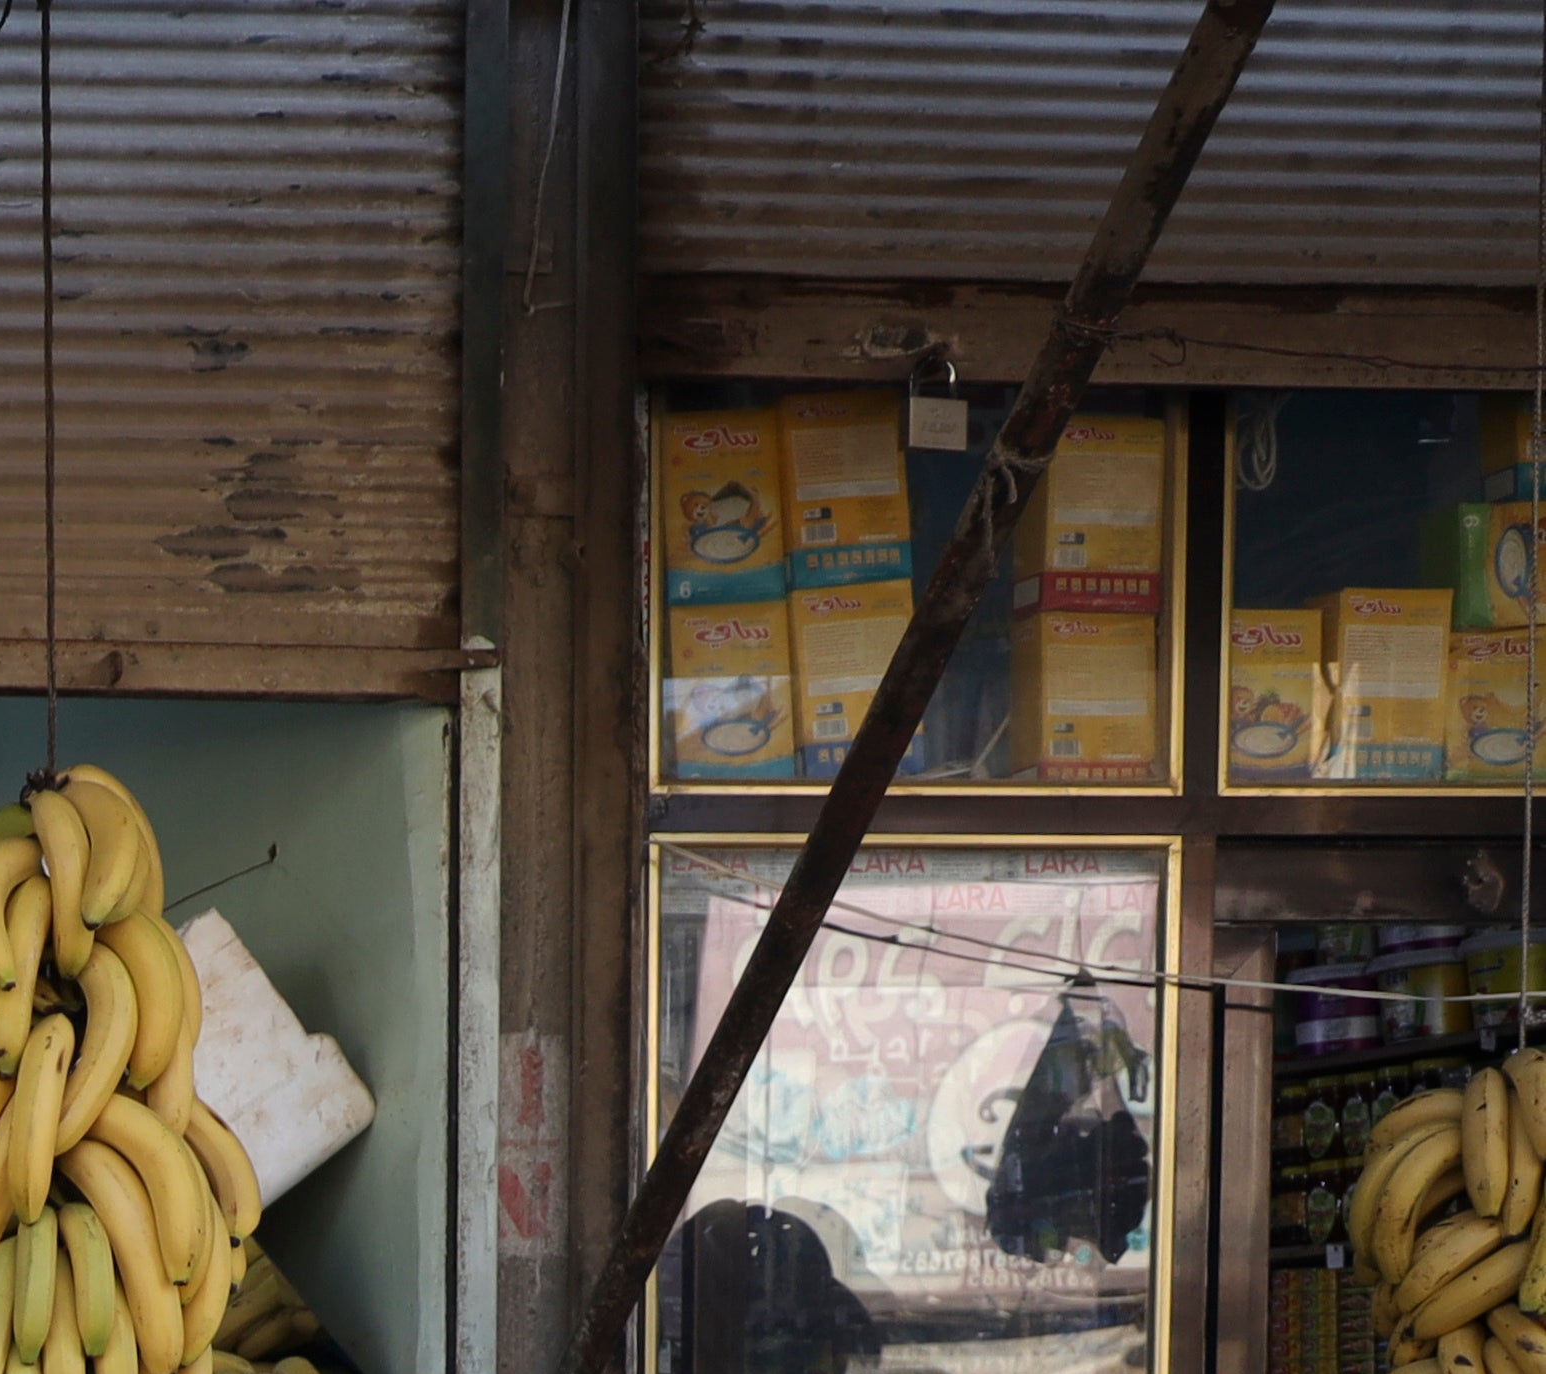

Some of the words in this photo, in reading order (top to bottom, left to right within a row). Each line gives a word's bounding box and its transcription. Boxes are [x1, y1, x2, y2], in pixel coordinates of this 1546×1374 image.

[850, 850, 925, 874] LARA
[1024, 852, 1101, 874] LARA
[933, 885, 1007, 911] LARA
